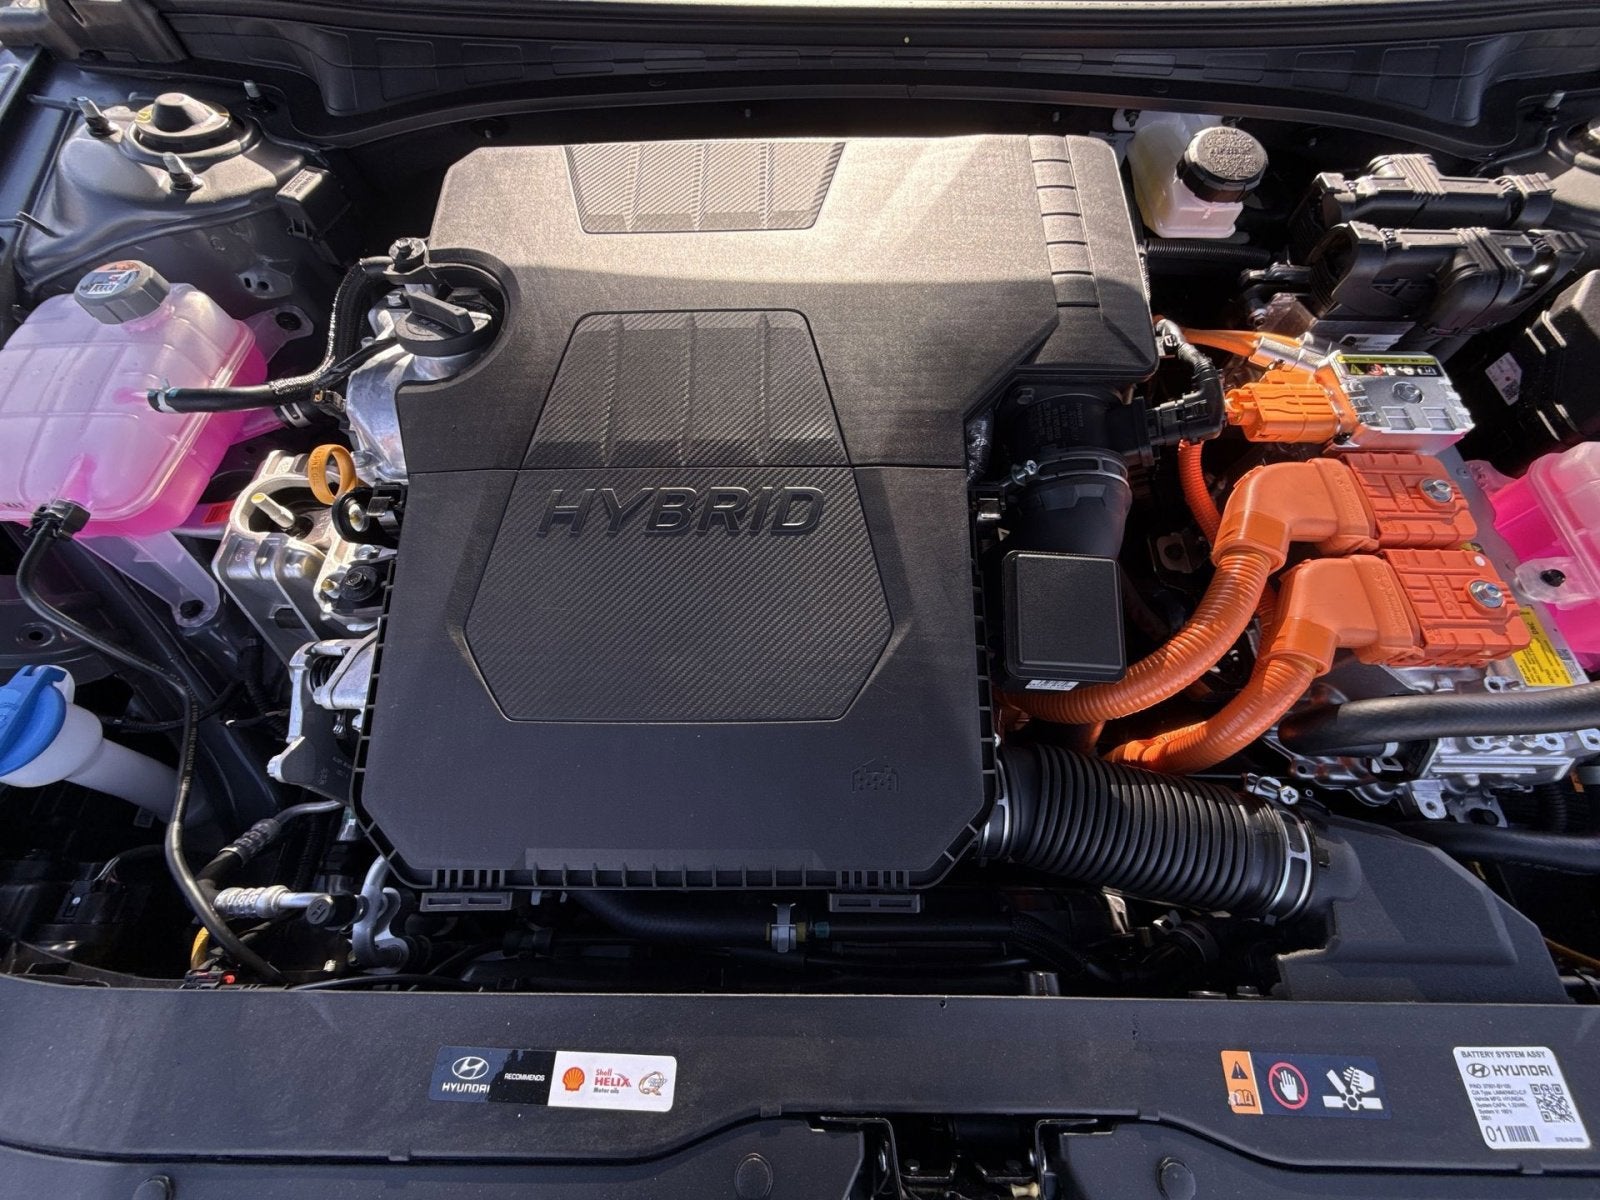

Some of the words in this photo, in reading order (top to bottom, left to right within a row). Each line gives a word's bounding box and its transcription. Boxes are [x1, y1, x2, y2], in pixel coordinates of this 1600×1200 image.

[537, 487, 825, 536] HYBRID
[1461, 1050, 1495, 1059] BATTERY
[1495, 1050, 1526, 1059] SYSTEM
[1527, 1050, 1547, 1059] ASSY
[596, 1068, 613, 1077] Shell
[1491, 1064, 1554, 1077] HYUNDAI
[504, 1072, 545, 1082] RECOMMENDS
[595, 1076, 632, 1088] HELIX
[442, 1082, 490, 1094] HYUNDAI
[1485, 1125, 1506, 1143] 01
